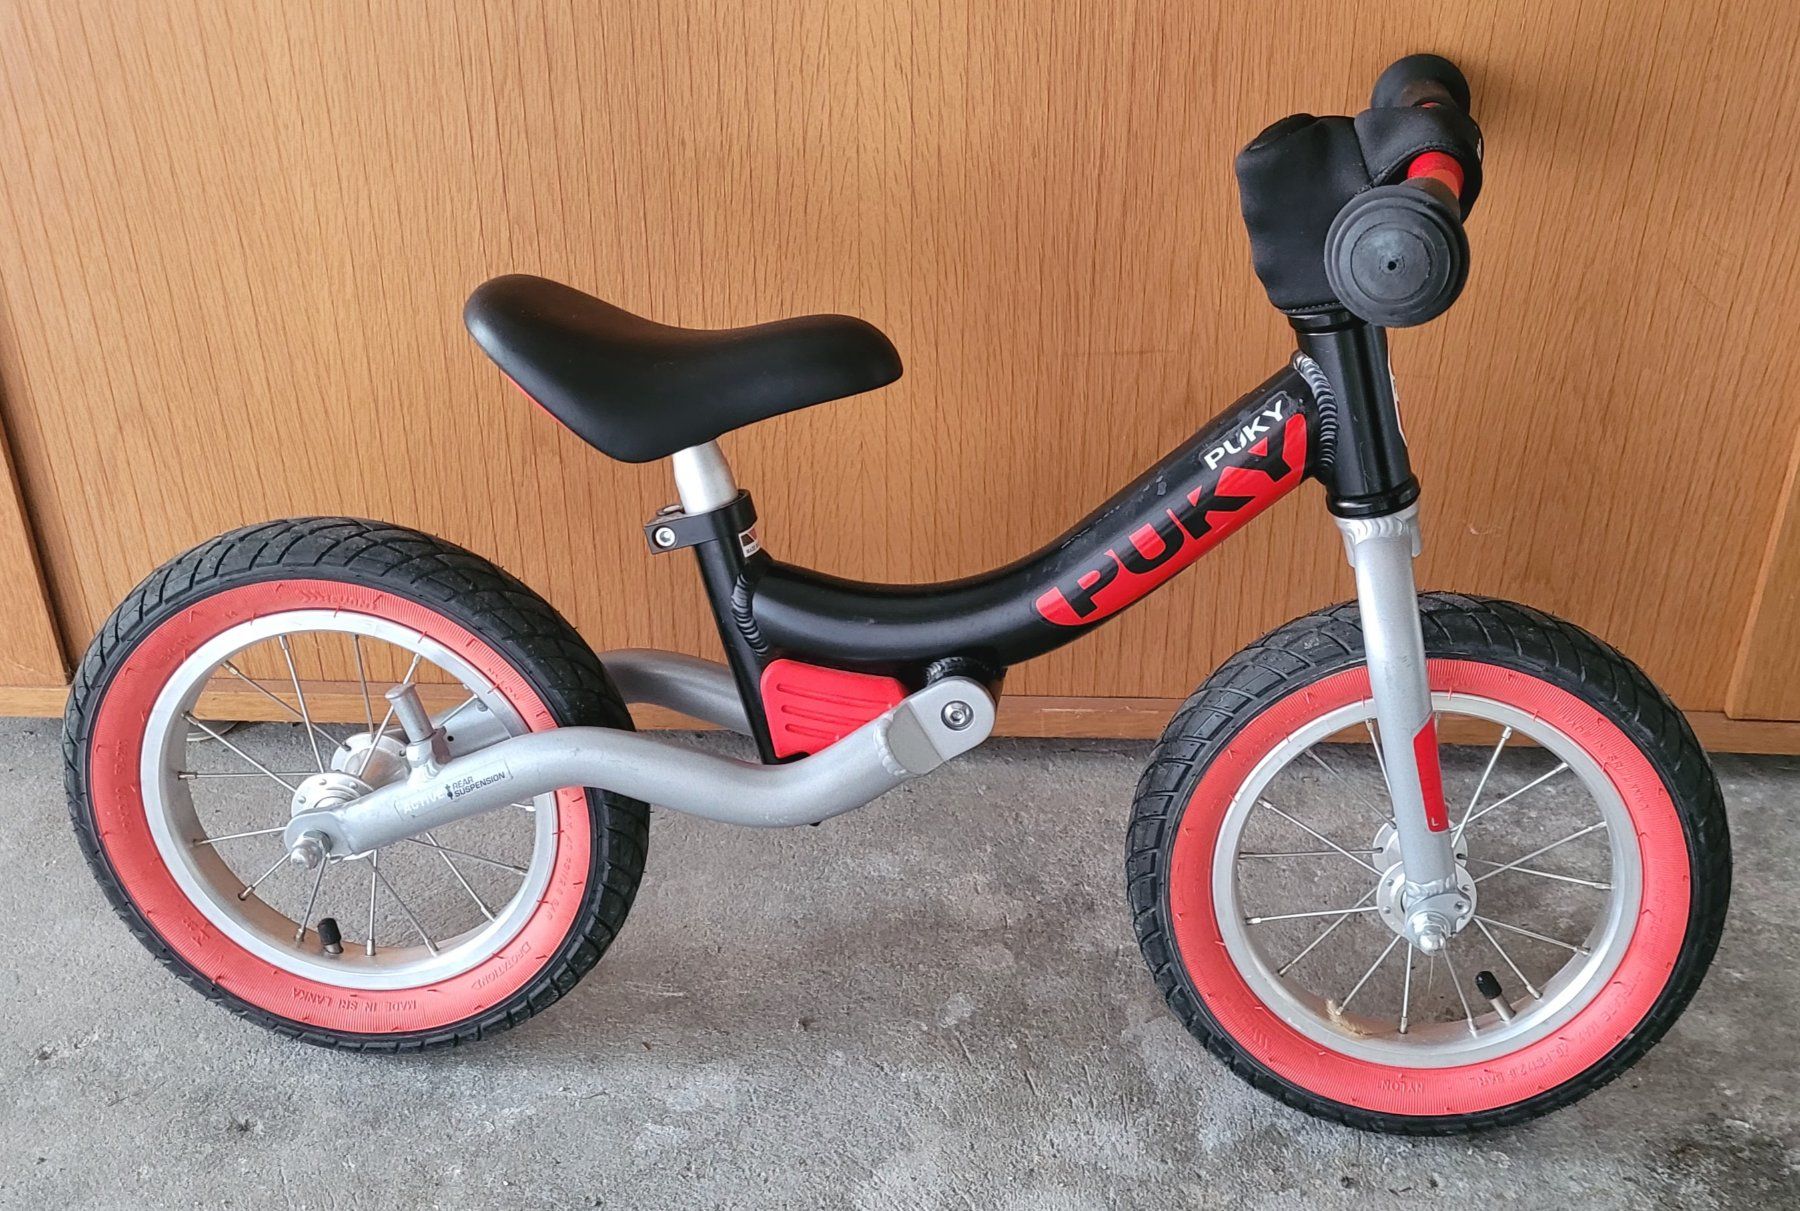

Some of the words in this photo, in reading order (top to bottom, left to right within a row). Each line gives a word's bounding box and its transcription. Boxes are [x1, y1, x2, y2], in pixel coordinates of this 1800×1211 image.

[1203, 400, 1284, 471] PUKY
[1068, 420, 1294, 618] PUKY
[452, 776, 474, 790] REAR
[454, 771, 506, 798] SUSPENSION
[1432, 817, 1439, 827] L
[293, 986, 333, 1008] LANKA
[339, 998, 359, 1011] SRI
[364, 1001, 378, 1012] IN
